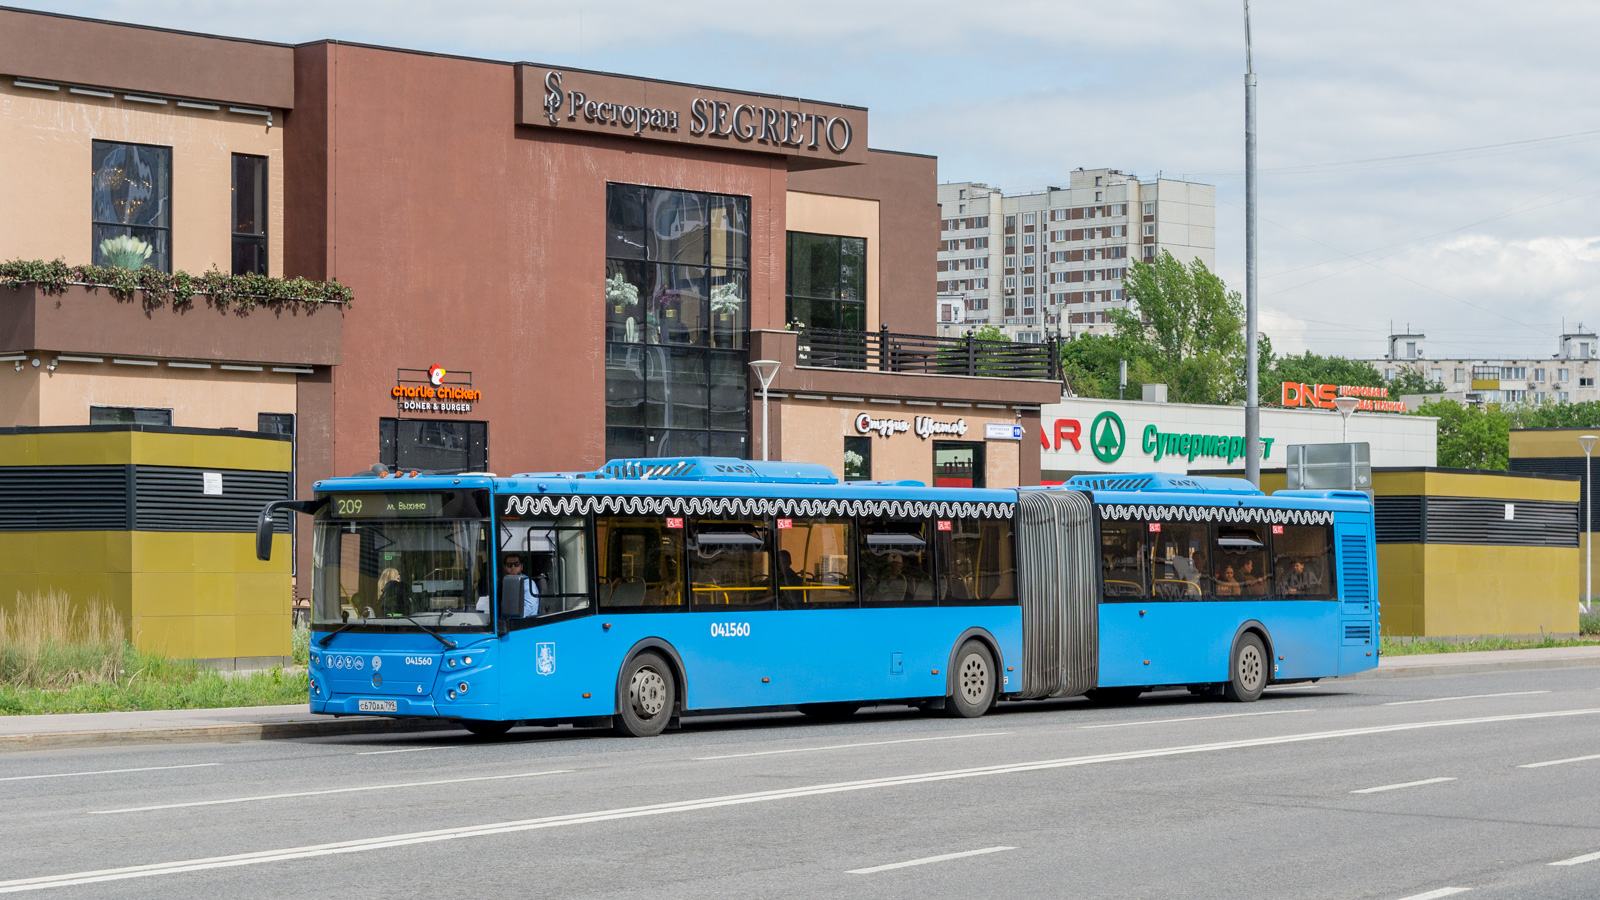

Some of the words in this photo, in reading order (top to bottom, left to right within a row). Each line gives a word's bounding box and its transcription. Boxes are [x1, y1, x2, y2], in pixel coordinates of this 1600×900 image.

[568, 90, 681, 134] Ресторан
[690, 97, 853, 151] SEGRETO
[392, 385, 435, 398] charlie
[437, 387, 482, 400] chicken
[1282, 381, 1337, 408] DNS
[1340, 385, 1381, 397] ЦИФРОВАЯ
[404, 401, 431, 410] DÖNER
[433, 402, 438, 410] &
[441, 403, 470, 411] BURGER
[1374, 400, 1407, 412] ТЕХНИКА
[856, 413, 911, 436] Студия
[915, 416, 968, 438] Цветов
[337, 499, 363, 514] 209
[398, 501, 426, 510] Выхино
[710, 622, 751, 637] 041560
[405, 656, 432, 665] 041560
[417, 684, 422, 693] 6
